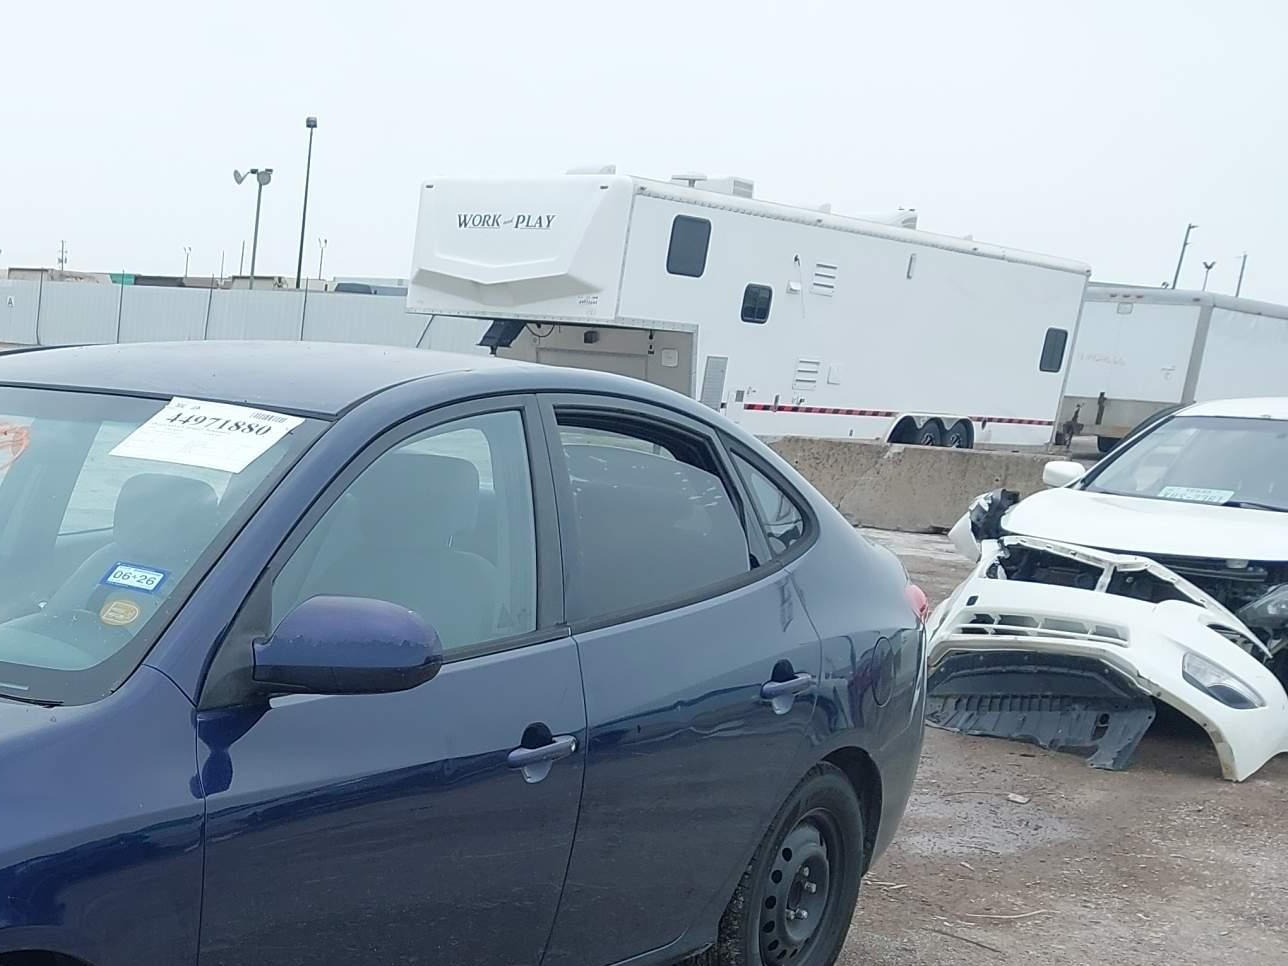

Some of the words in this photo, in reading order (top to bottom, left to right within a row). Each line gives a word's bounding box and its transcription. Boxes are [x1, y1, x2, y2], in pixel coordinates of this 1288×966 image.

[457, 213, 502, 229] WORK
[514, 214, 556, 230] PLAY
[165, 411, 273, 437] 44971880
[112, 570, 133, 581] 06
[135, 574, 157, 586] 26
